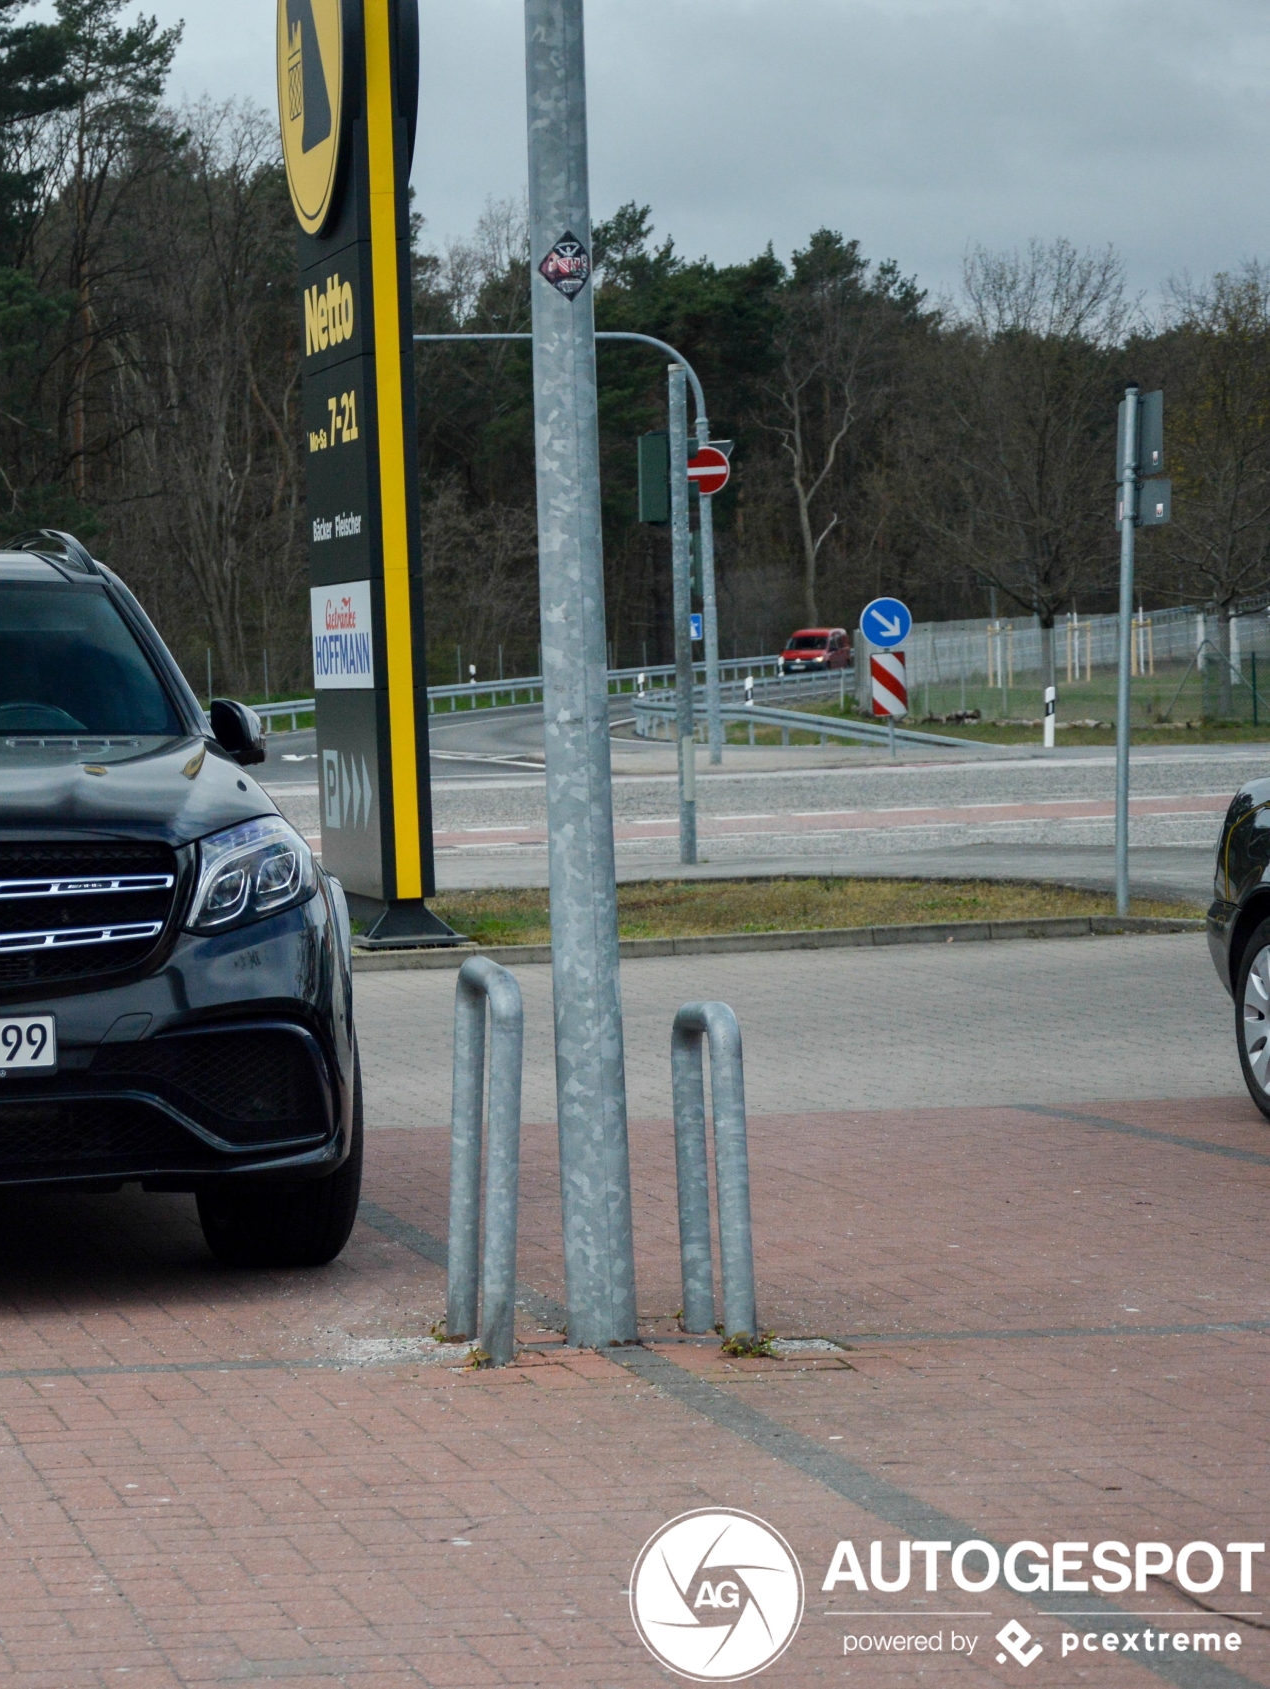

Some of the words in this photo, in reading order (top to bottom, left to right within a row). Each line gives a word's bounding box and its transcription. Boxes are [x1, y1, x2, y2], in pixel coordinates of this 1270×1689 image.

[304, 273, 354, 357] Netto
[328, 389, 359, 446] 7-21
[313, 517, 332, 542] Bäcker
[334, 511, 361, 538] Fleischer
[325, 596, 356, 630] Getränke
[315, 632, 370, 676] HOFFMANN
